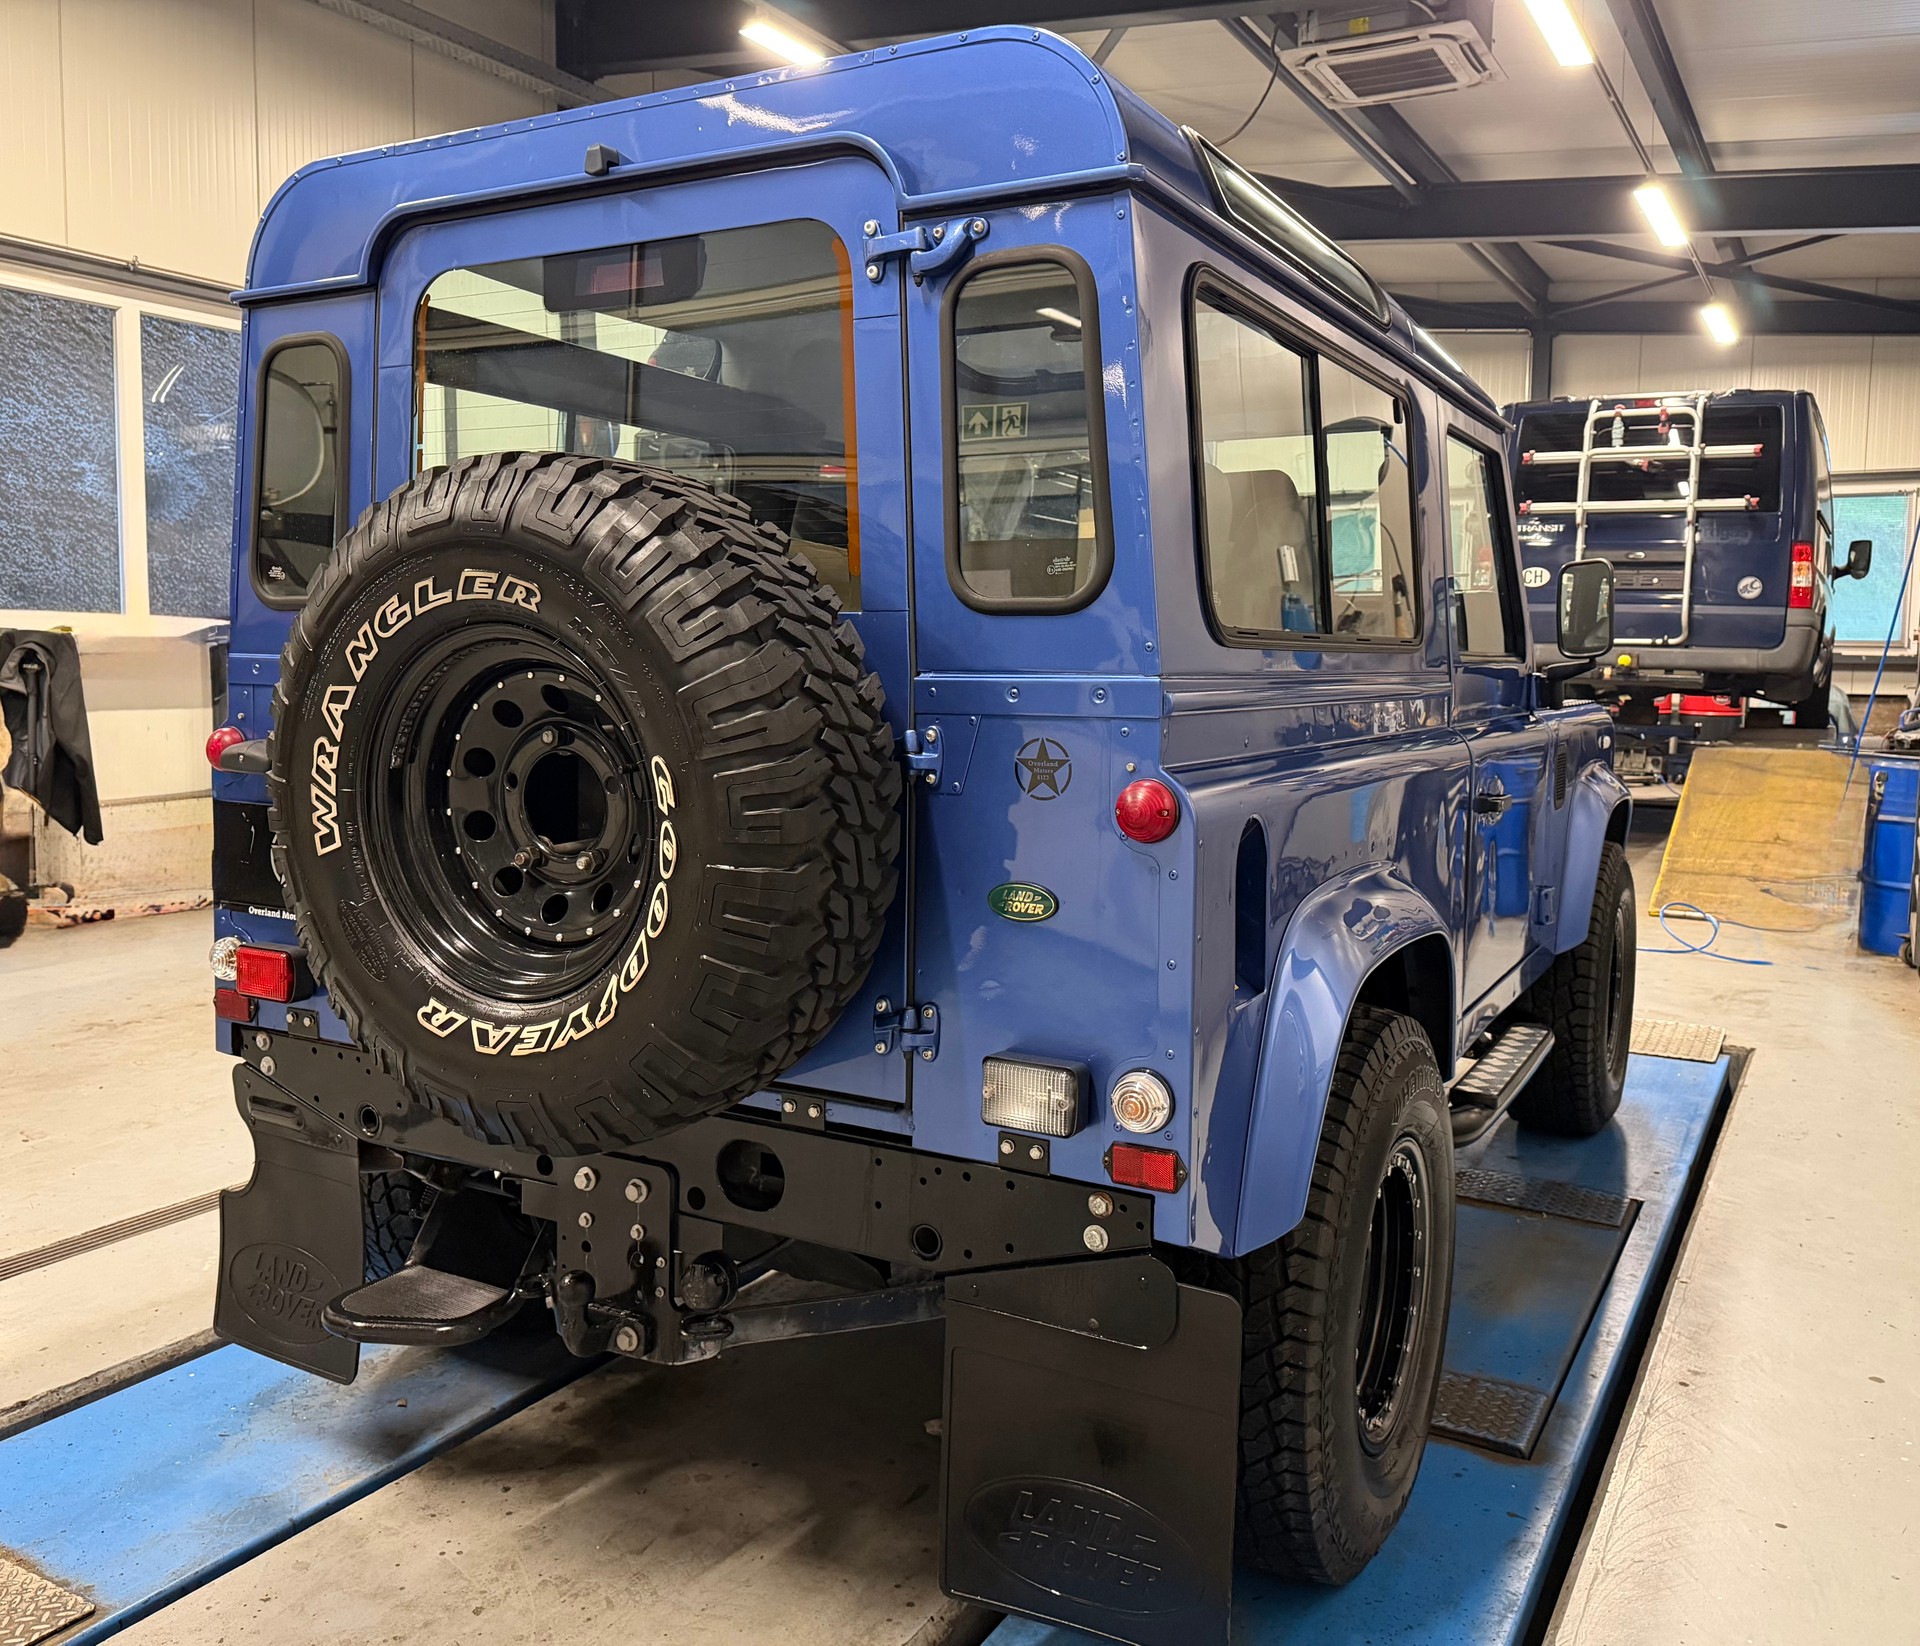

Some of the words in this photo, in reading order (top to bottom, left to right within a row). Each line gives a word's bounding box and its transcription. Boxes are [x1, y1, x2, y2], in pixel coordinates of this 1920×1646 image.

[1517, 523, 1566, 533] TRANSIT
[1524, 569, 1544, 585] CH
[310, 568, 542, 857] WRANGLER
[1002, 889, 1034, 903] LAND
[248, 905, 281, 919] Overland
[416, 755, 678, 1057] GOODYEAR
[1004, 901, 1045, 915] ROVER
